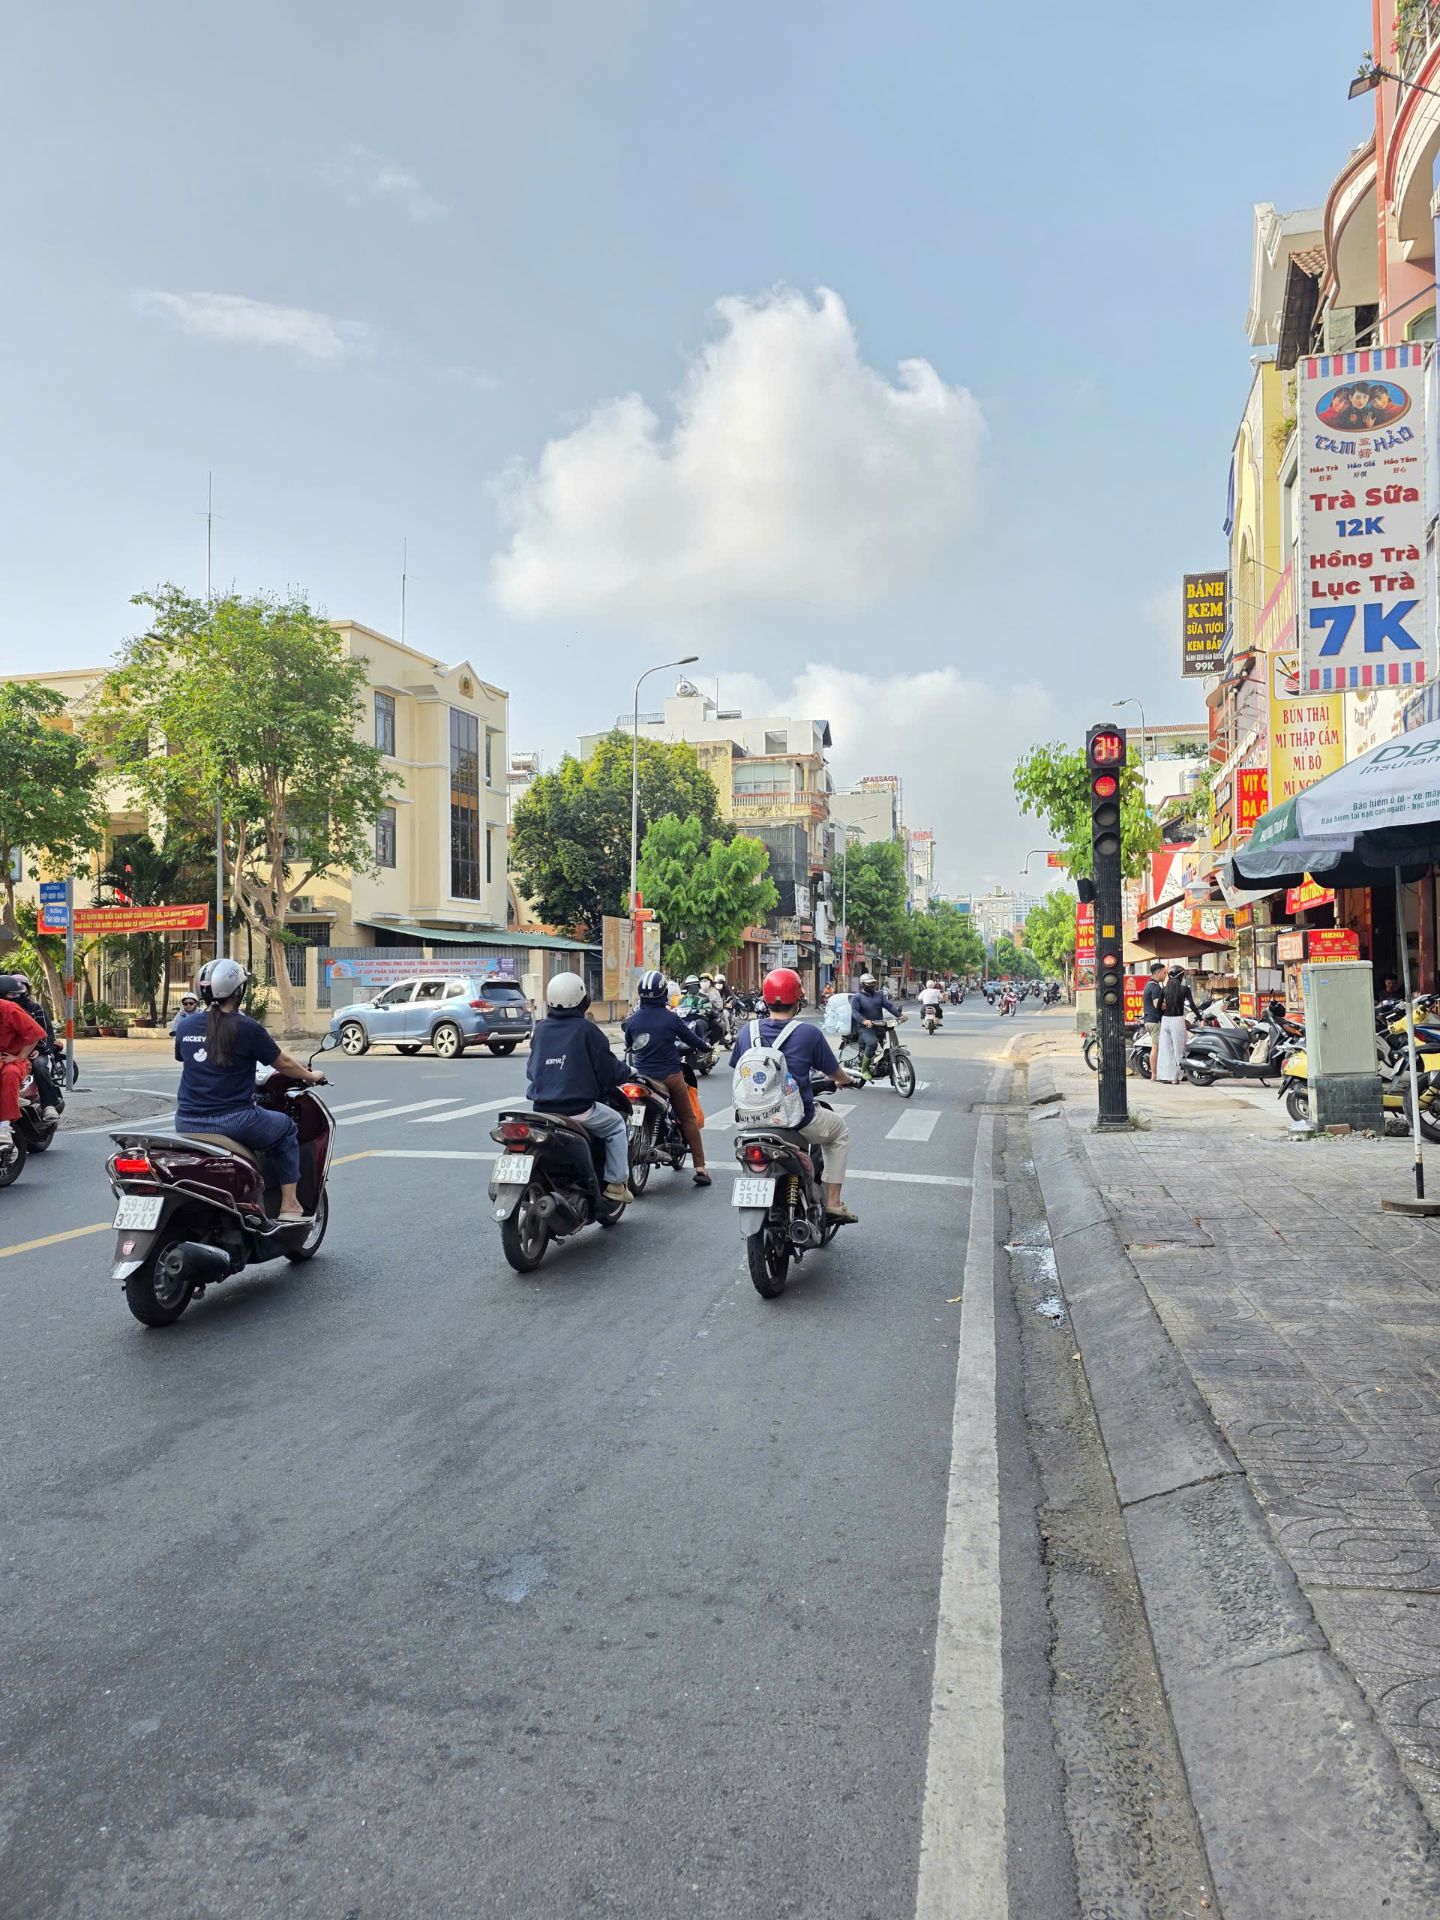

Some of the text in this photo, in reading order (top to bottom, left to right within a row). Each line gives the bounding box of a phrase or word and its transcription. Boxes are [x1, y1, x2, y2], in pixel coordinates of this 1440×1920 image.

[1315, 434, 1356, 455] TAM
[1309, 484, 1419, 511] Trà Sữa
[1336, 516, 1385, 537] 12K
[1310, 544, 1420, 570] Hồng Trà
[1186, 579, 1225, 599] BÁNH
[1311, 571, 1415, 601] Lục Trà
[1187, 602, 1223, 619] KEM
[1186, 621, 1224, 635] SỮA TƯƠI
[1309, 599, 1422, 657] 7K
[1187, 640, 1204, 652] KEM
[1195, 662, 1214, 671] 99K
[1283, 702, 1330, 725] BÚN THÁI
[1275, 730, 1287, 748] MÌ
[1290, 728, 1316, 750] THẬP
[1293, 750, 1322, 771] MÌ BÒ
[1370, 740, 1440, 764] DB
[1242, 774, 1259, 796] VỊT
[1283, 776, 1296, 796] MÌ
[1413, 792, 1423, 800] xe
[1426, 799, 1440, 808] sinh
[1242, 800, 1257, 817] DA
[1321, 931, 1345, 939] MENU
[182, 1035, 207, 1043] MICKEY
